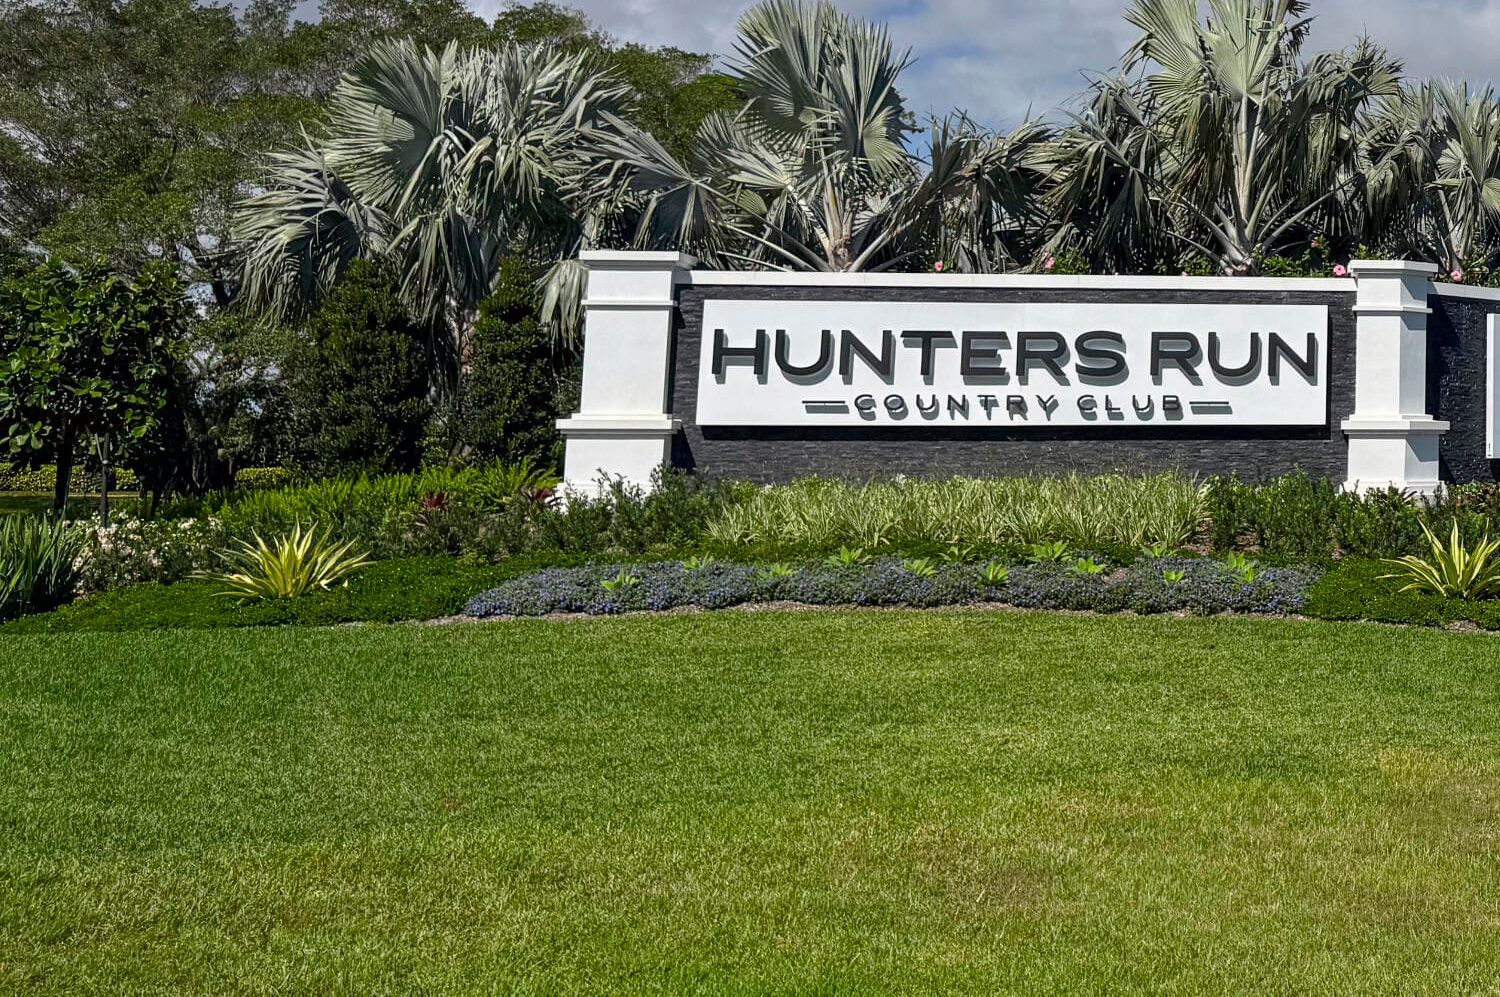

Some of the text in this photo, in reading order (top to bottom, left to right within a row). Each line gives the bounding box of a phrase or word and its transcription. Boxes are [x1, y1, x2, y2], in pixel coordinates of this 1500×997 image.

[711, 328, 1316, 378] HUNTERS RUN
[854, 393, 1180, 412] COUNTRY CLUB
